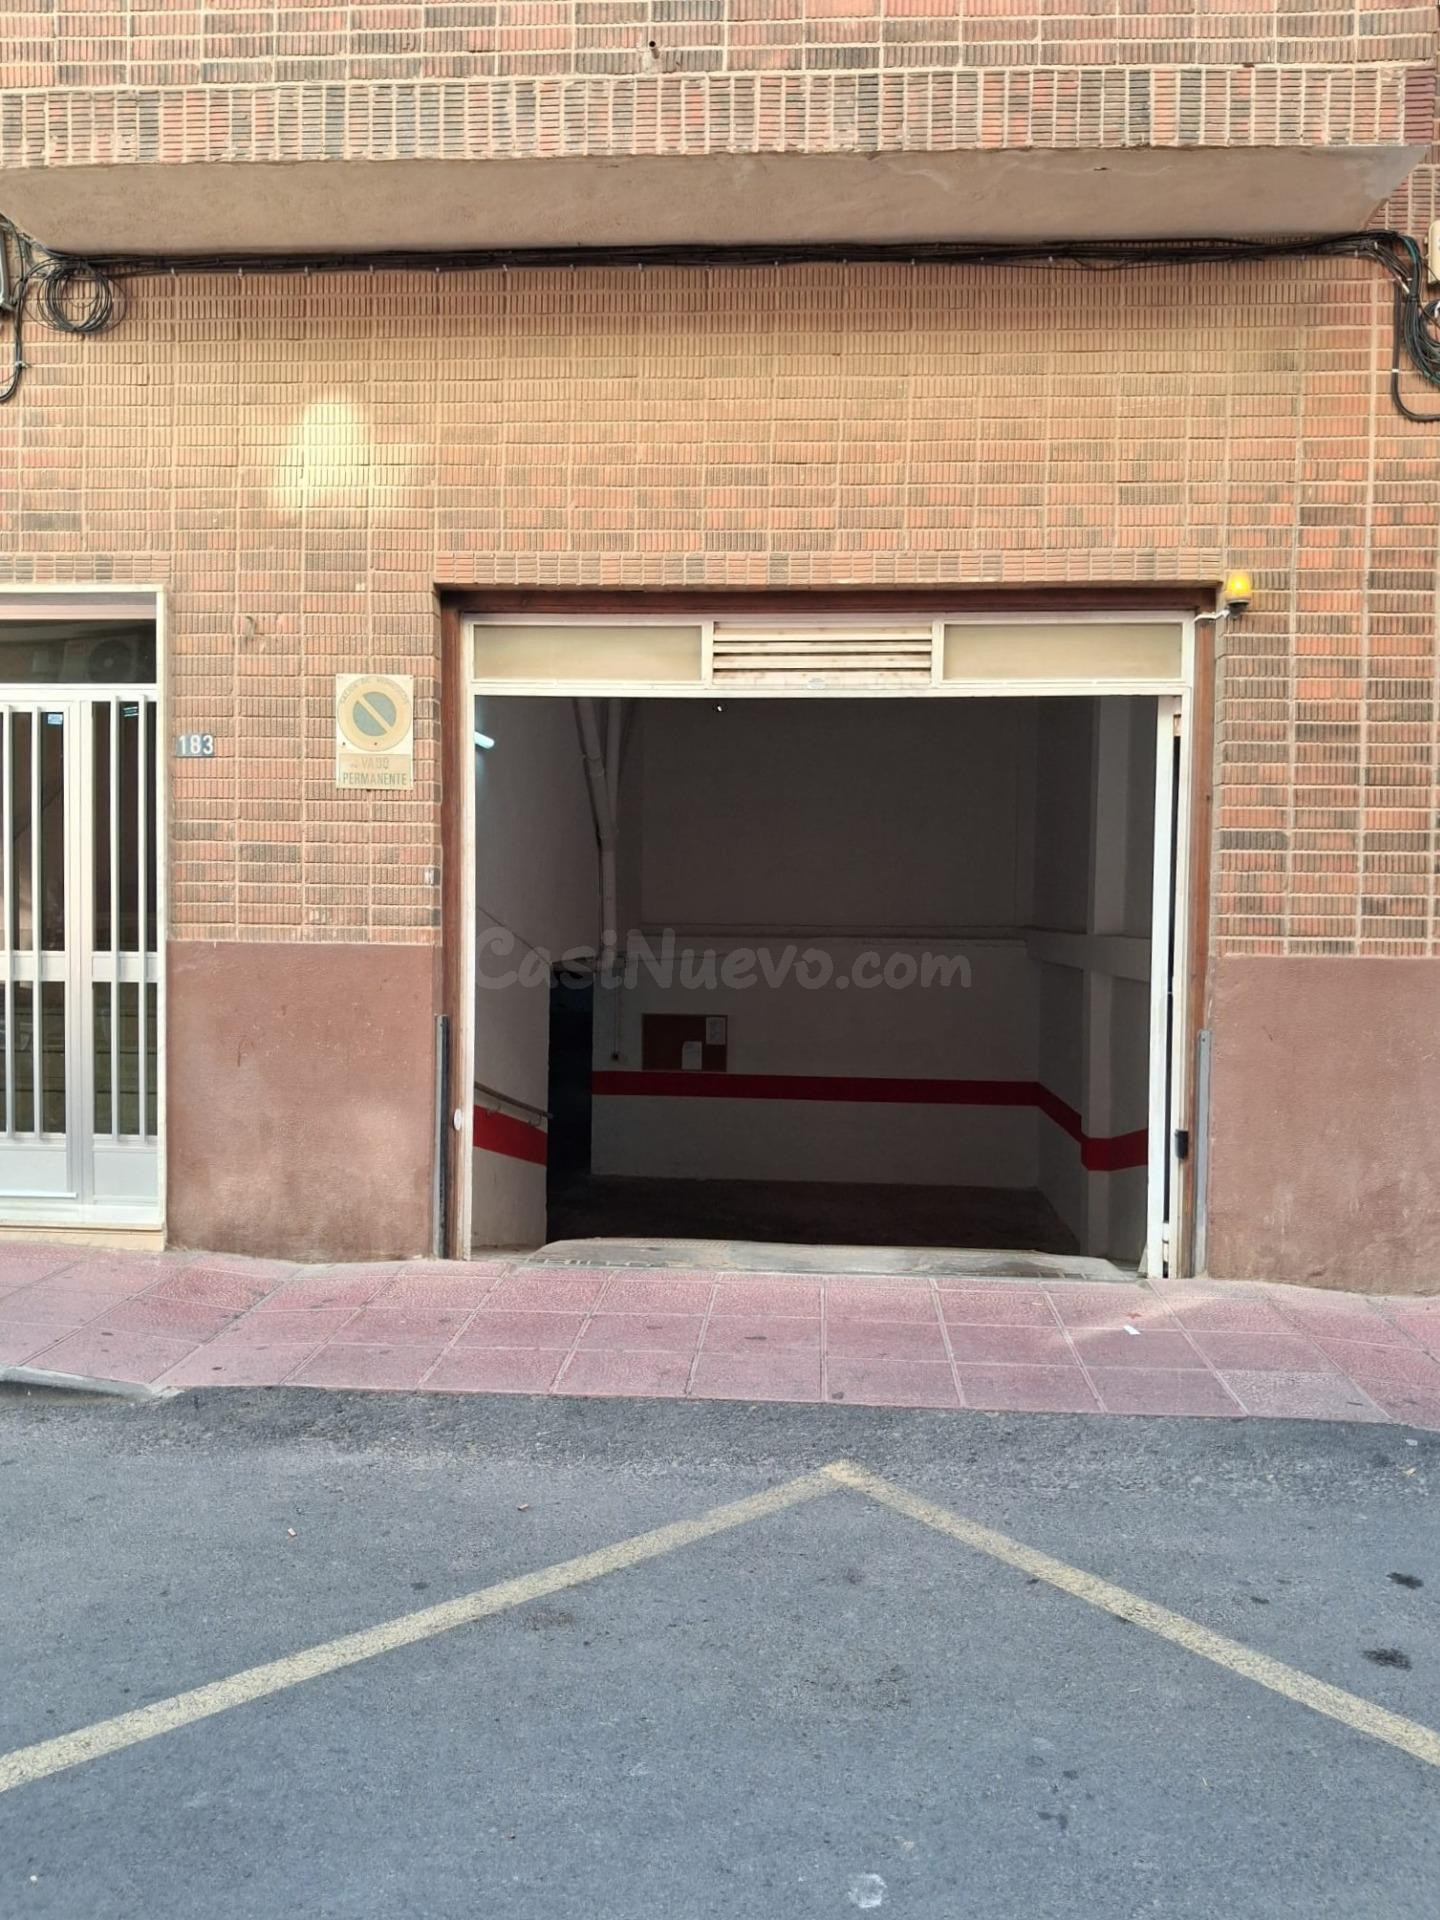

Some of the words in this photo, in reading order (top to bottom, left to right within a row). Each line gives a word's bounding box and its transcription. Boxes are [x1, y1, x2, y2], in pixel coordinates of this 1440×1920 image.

[179, 735, 213, 755] 183
[361, 757, 389, 769] VADO
[343, 772, 407, 785] PERMANENTE
